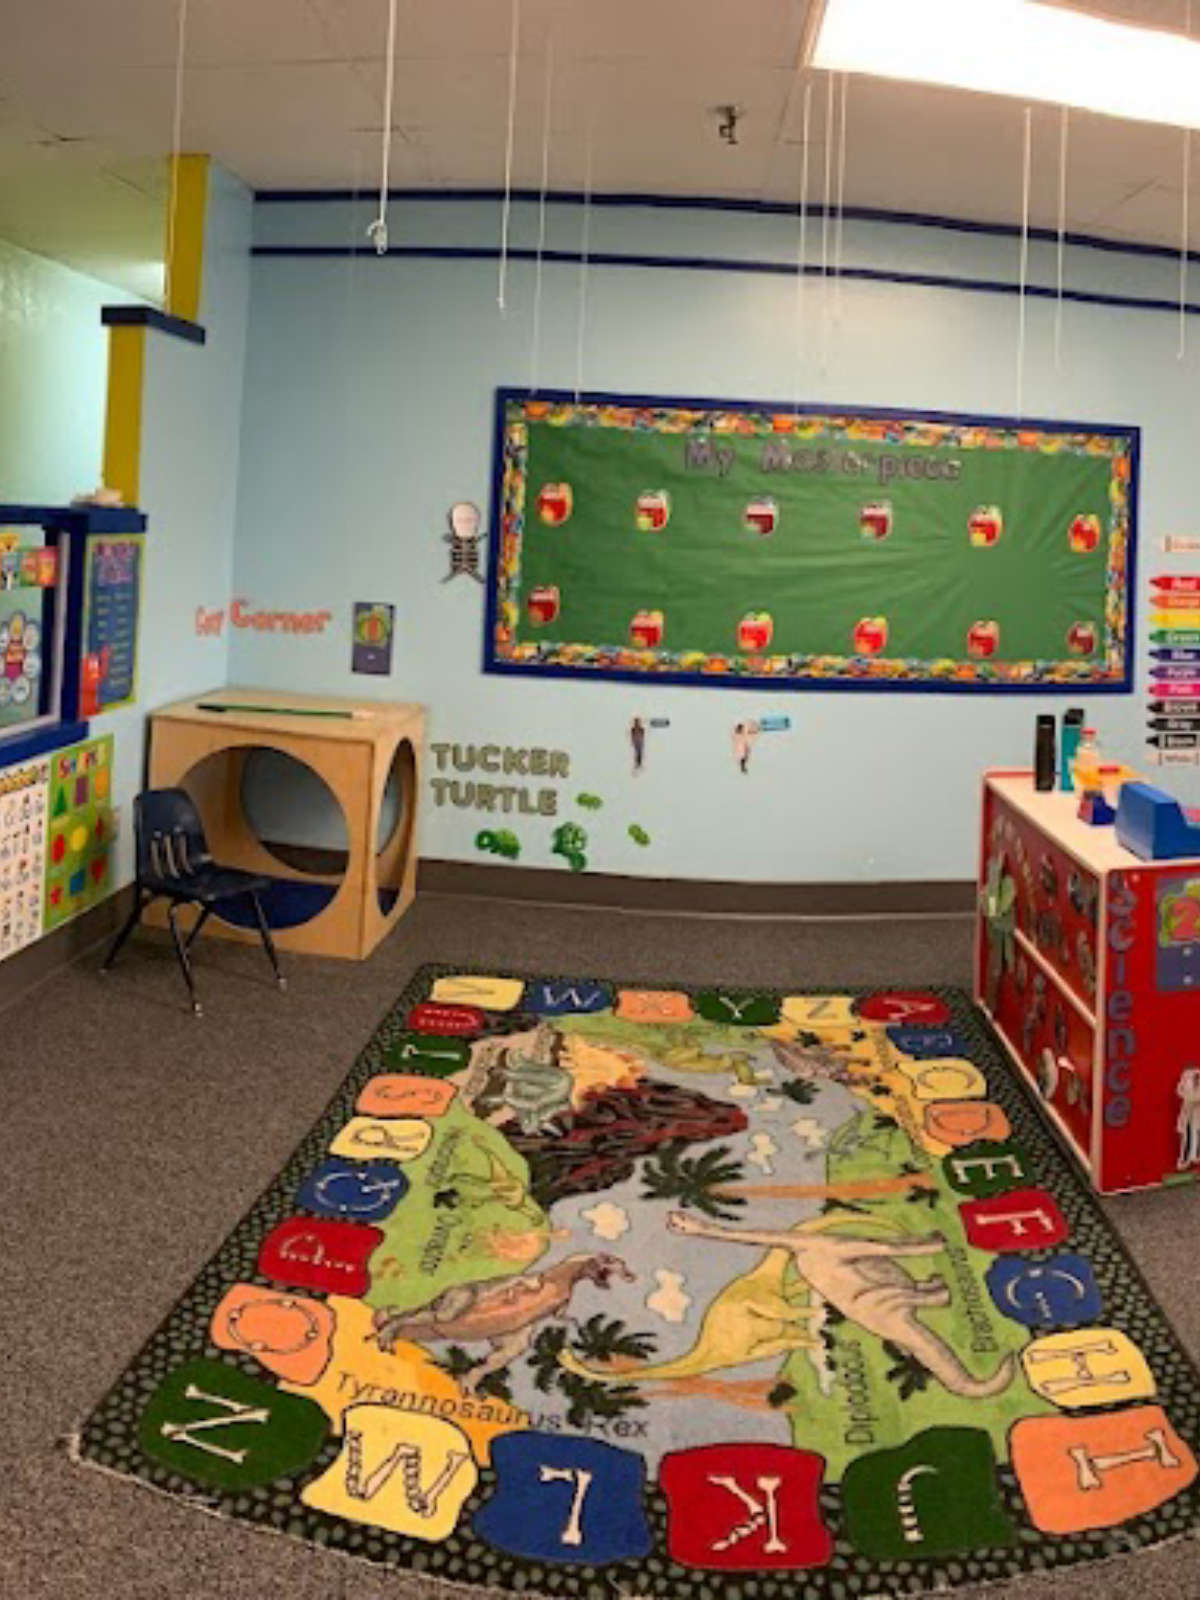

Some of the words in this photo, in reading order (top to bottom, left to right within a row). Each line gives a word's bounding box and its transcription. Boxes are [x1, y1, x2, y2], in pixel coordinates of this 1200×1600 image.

[430, 743, 570, 778] TUCKER
[429, 778, 557, 816] TURTLE
[719, 997, 755, 1019] Y
[951, 1154, 1025, 1183] E
[977, 1206, 1056, 1238] F
[1026, 1338, 1132, 1397] H
[336, 1370, 562, 1431] Tyrannosaurus
[538, 1463, 594, 1546] L
[706, 1474, 788, 1554] K
